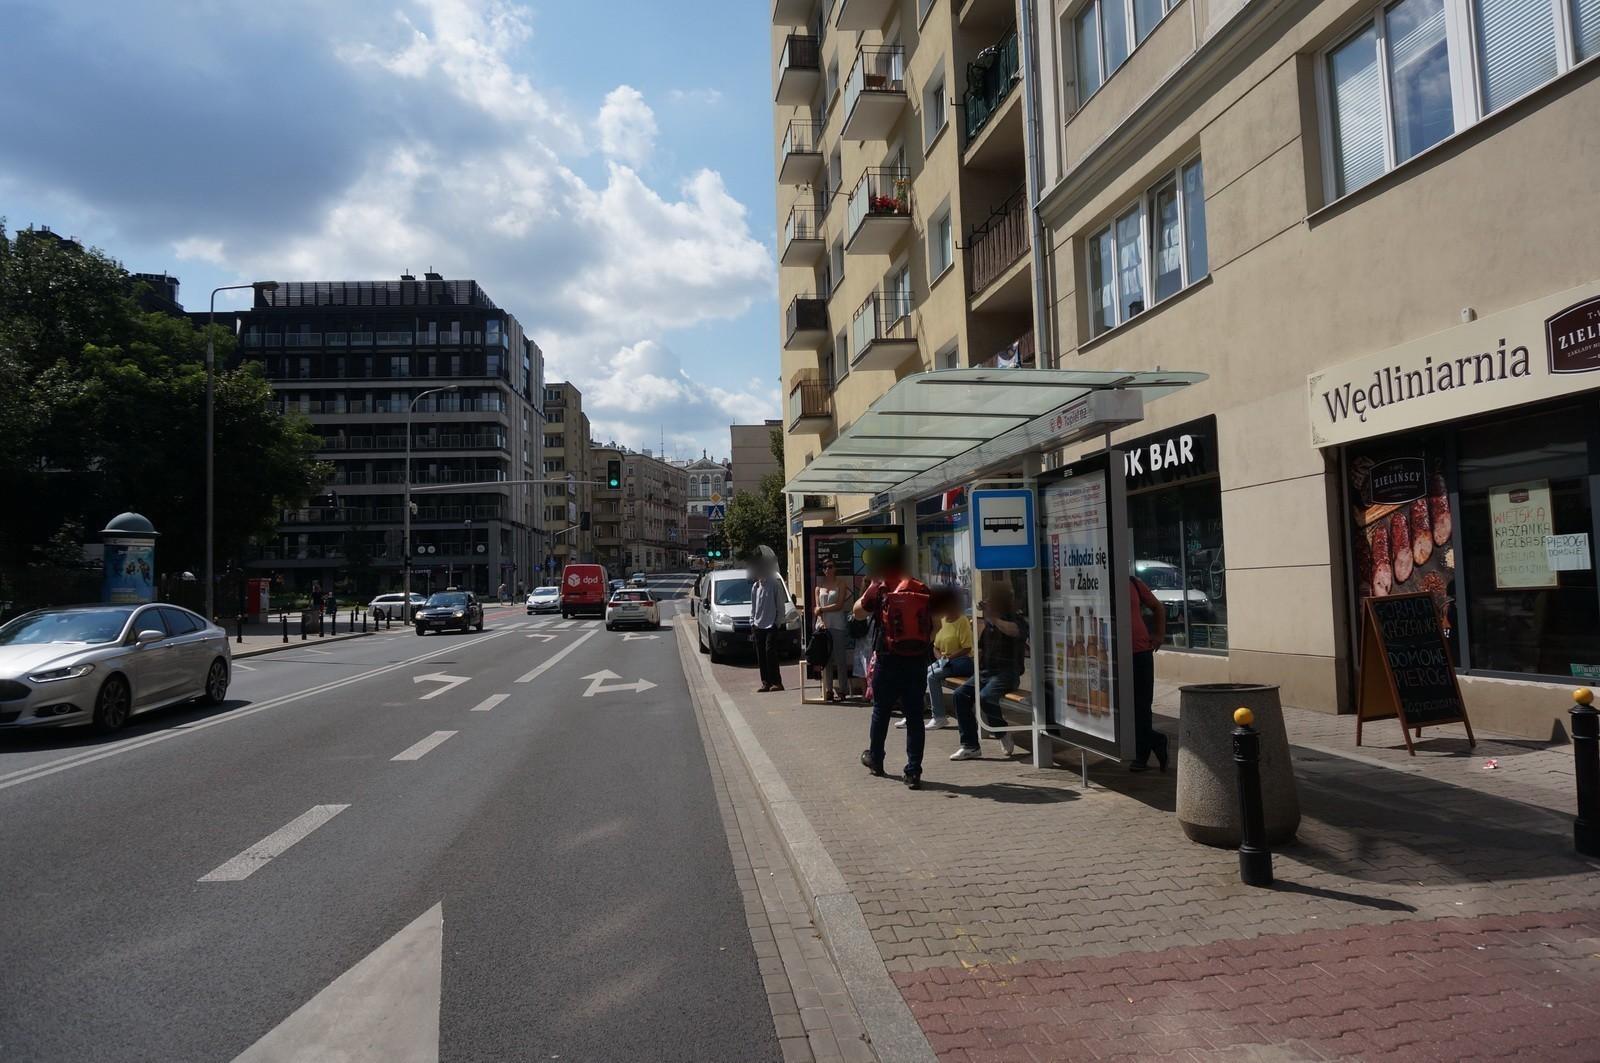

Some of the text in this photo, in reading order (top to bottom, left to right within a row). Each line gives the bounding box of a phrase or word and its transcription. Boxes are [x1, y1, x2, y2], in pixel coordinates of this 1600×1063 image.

[1323, 338, 1531, 423] Wędliniarnia
[1150, 434, 1194, 471] BAR
[1547, 535, 1587, 548] PIEROGI
[1095, 546, 1107, 569] się
[583, 576, 599, 584] dpd
[1077, 567, 1099, 591] Żabce
[1389, 648, 1448, 668] DOMOWE
